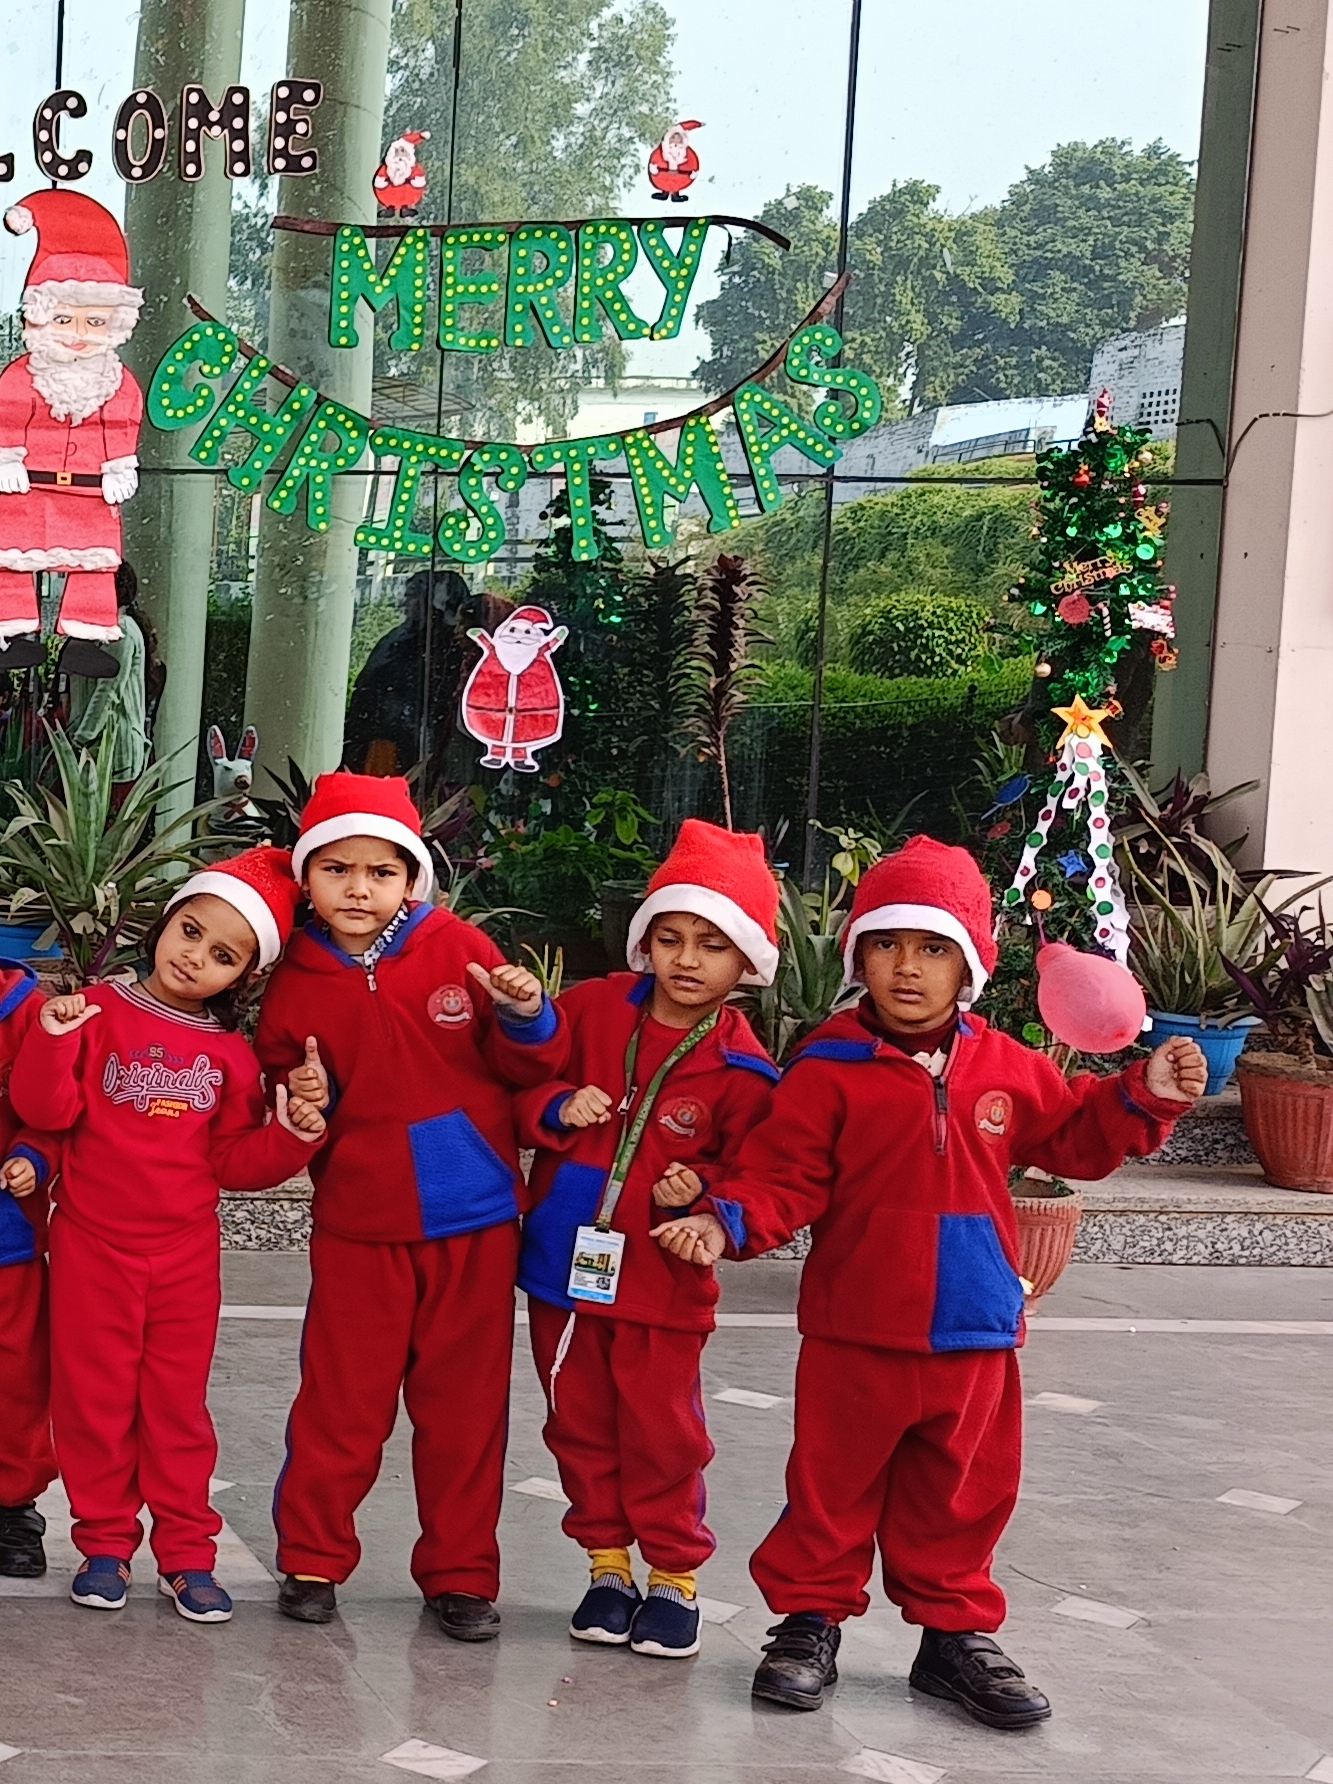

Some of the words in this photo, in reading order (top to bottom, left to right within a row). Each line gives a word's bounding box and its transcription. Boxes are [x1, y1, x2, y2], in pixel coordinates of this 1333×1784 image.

[328, 216, 711, 352] MERRY
[147, 319, 881, 563] CHRISTMAS
[1050, 562, 1134, 595] Christmas
[1062, 550, 1117, 577] Merry
[103, 1052, 224, 1112] Originals
